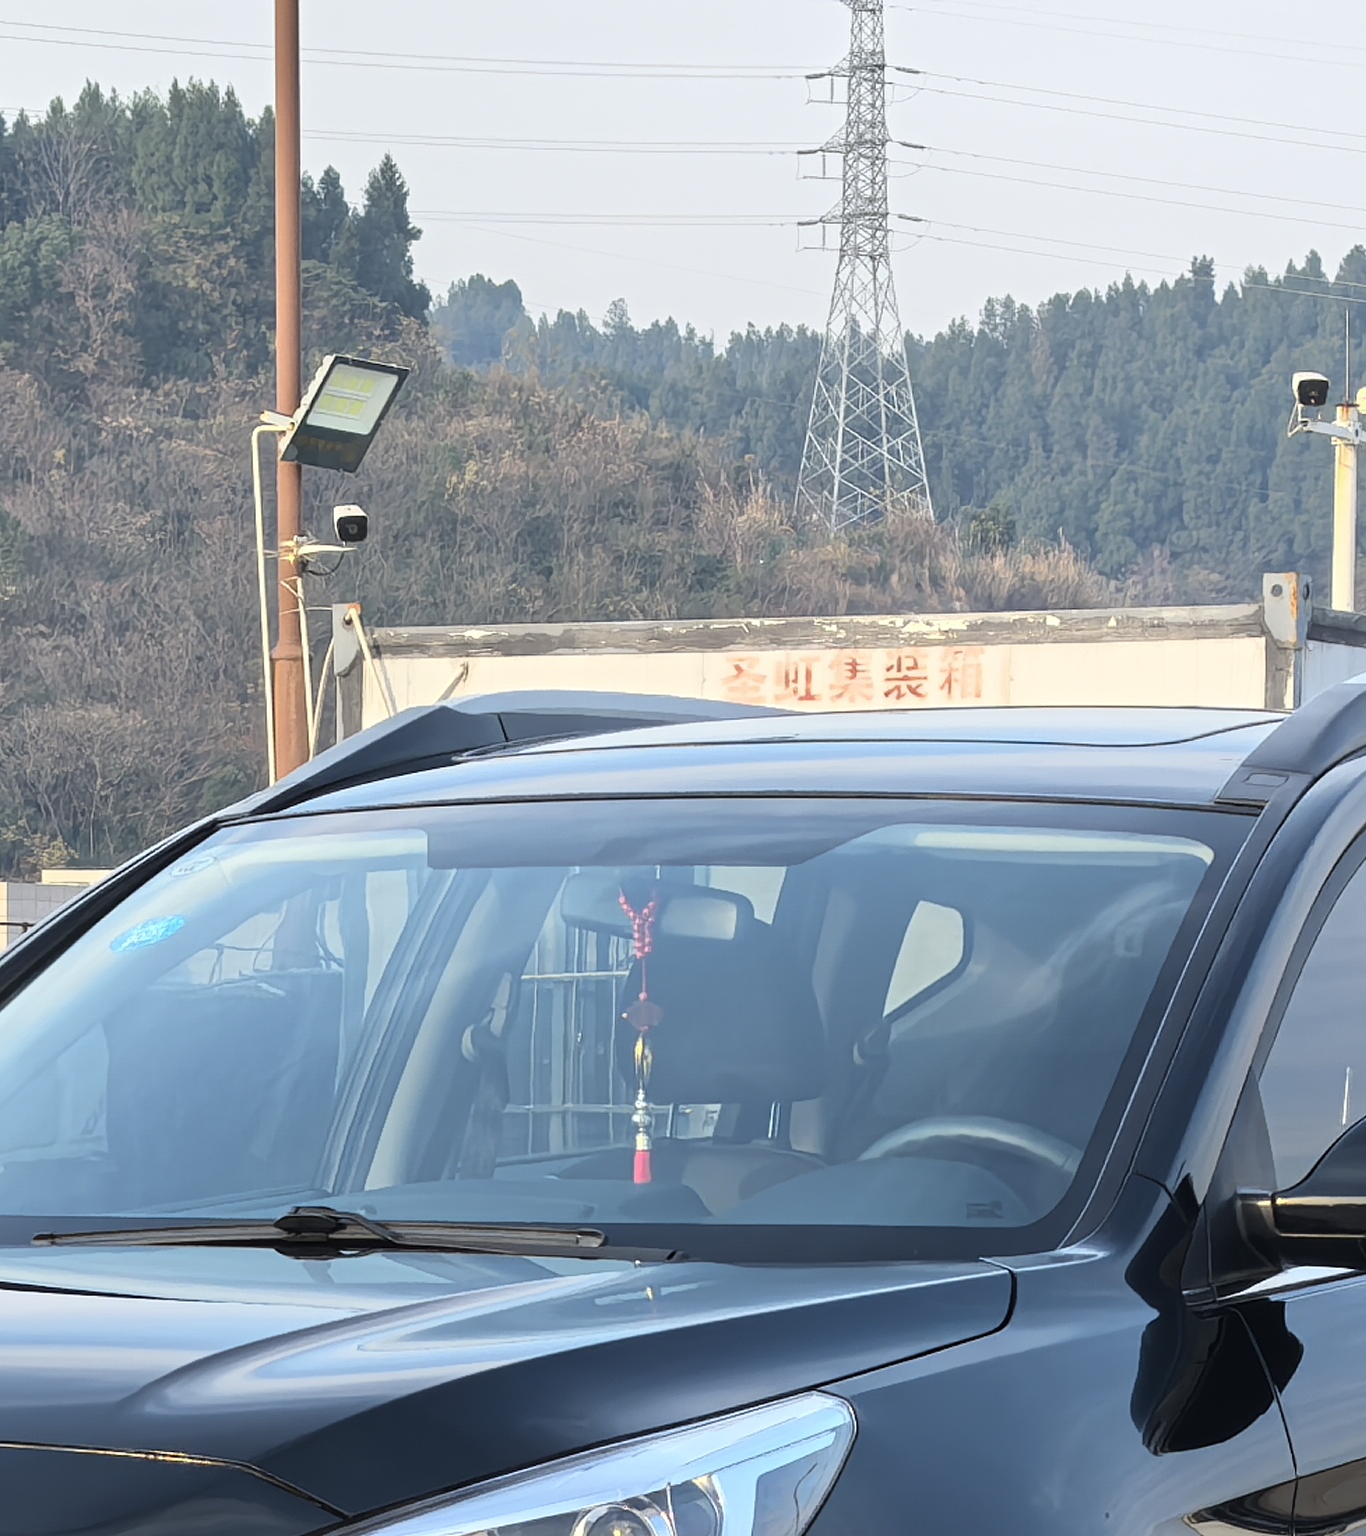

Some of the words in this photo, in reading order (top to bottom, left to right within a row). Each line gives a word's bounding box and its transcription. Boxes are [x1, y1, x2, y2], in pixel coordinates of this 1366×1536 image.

[722, 648, 984, 703] 圣虹集装箱
